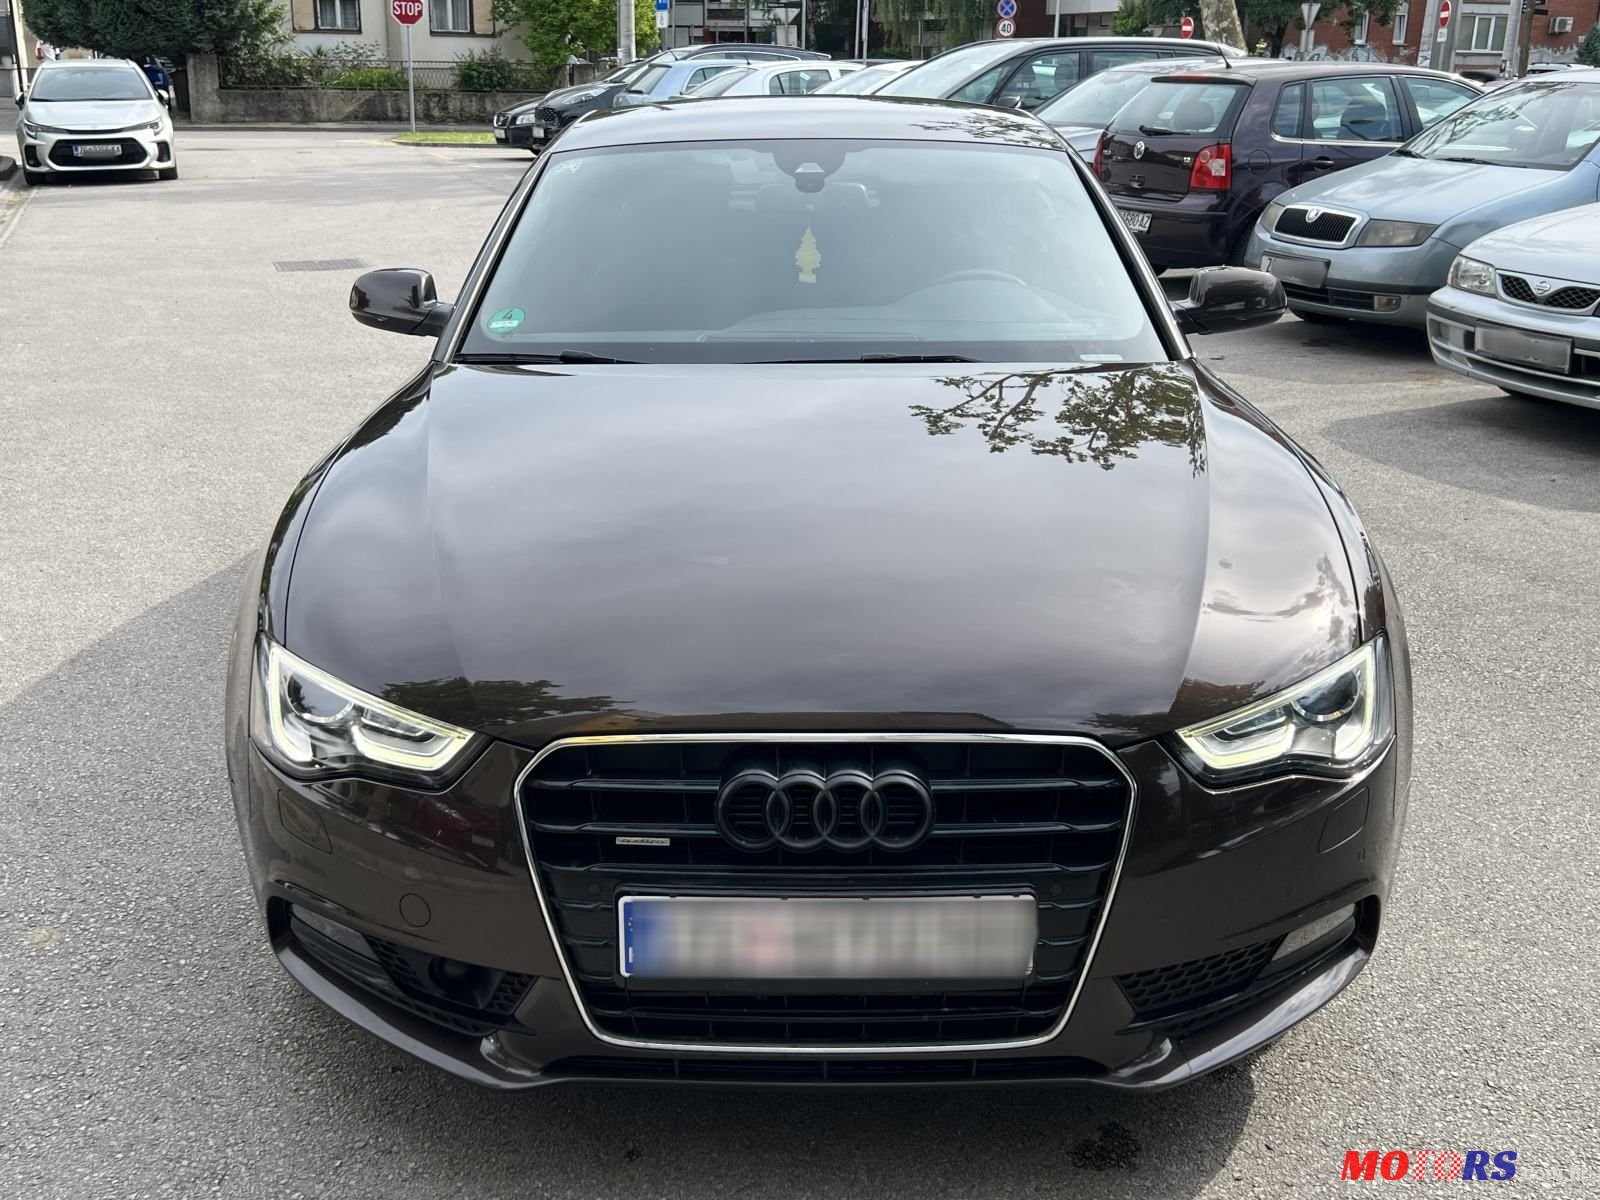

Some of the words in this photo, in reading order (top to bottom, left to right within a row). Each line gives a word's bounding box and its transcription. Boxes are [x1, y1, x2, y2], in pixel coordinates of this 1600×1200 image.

[393, 1, 422, 16] STOP
[1000, 23, 1012, 33] 40
[502, 309, 513, 320] 4
